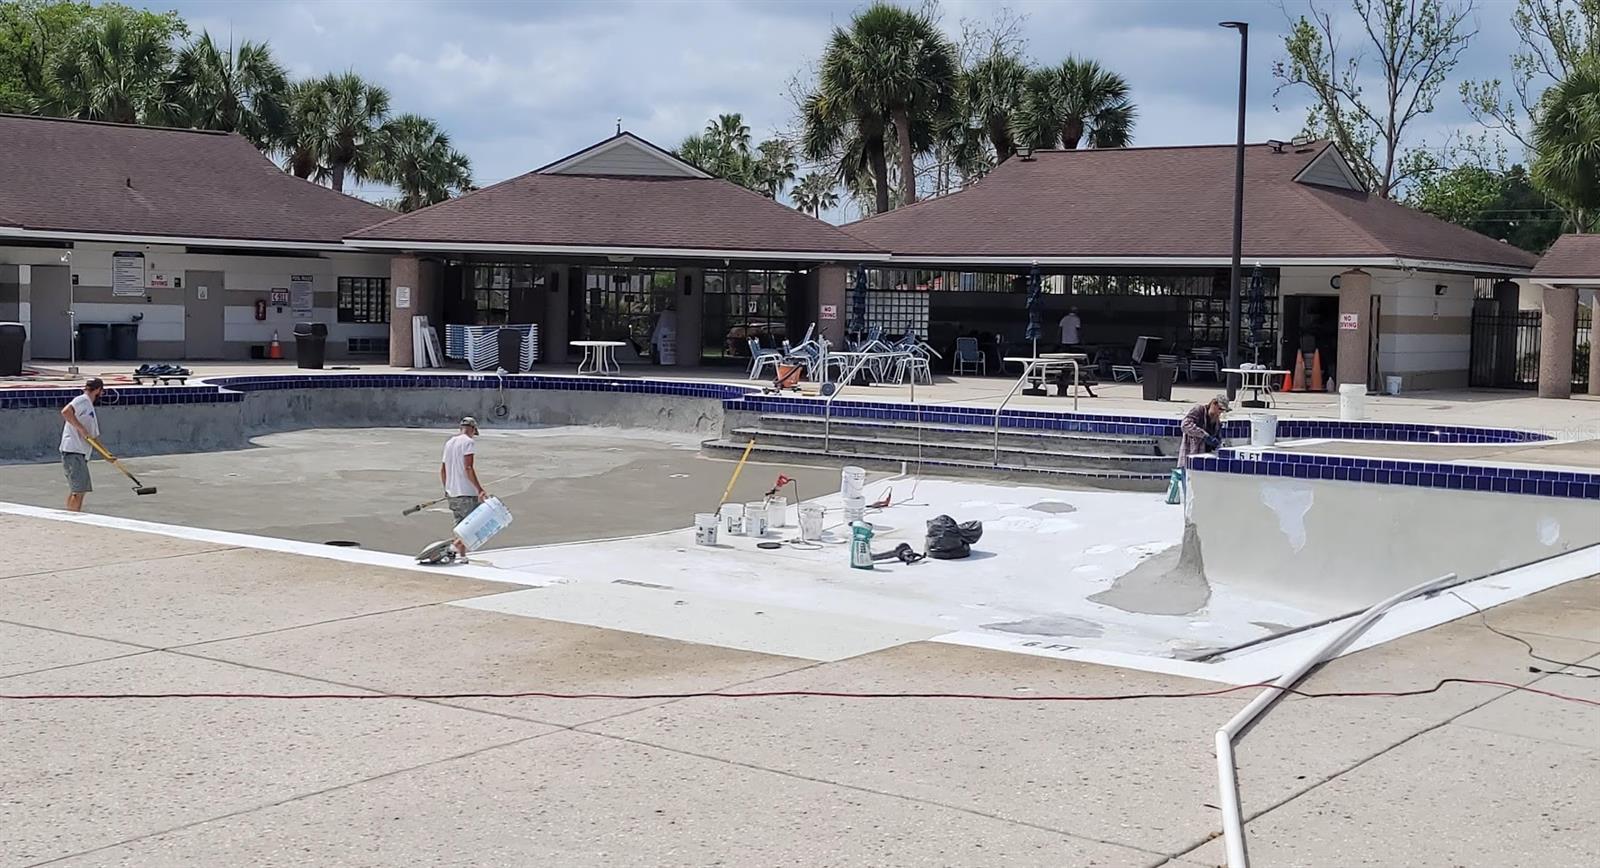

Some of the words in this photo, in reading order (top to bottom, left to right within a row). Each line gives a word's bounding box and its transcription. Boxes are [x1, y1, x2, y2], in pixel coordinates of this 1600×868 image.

[1239, 451, 1245, 460] 5
[1249, 452, 1260, 461] FT
[1043, 644, 1081, 652] FT
